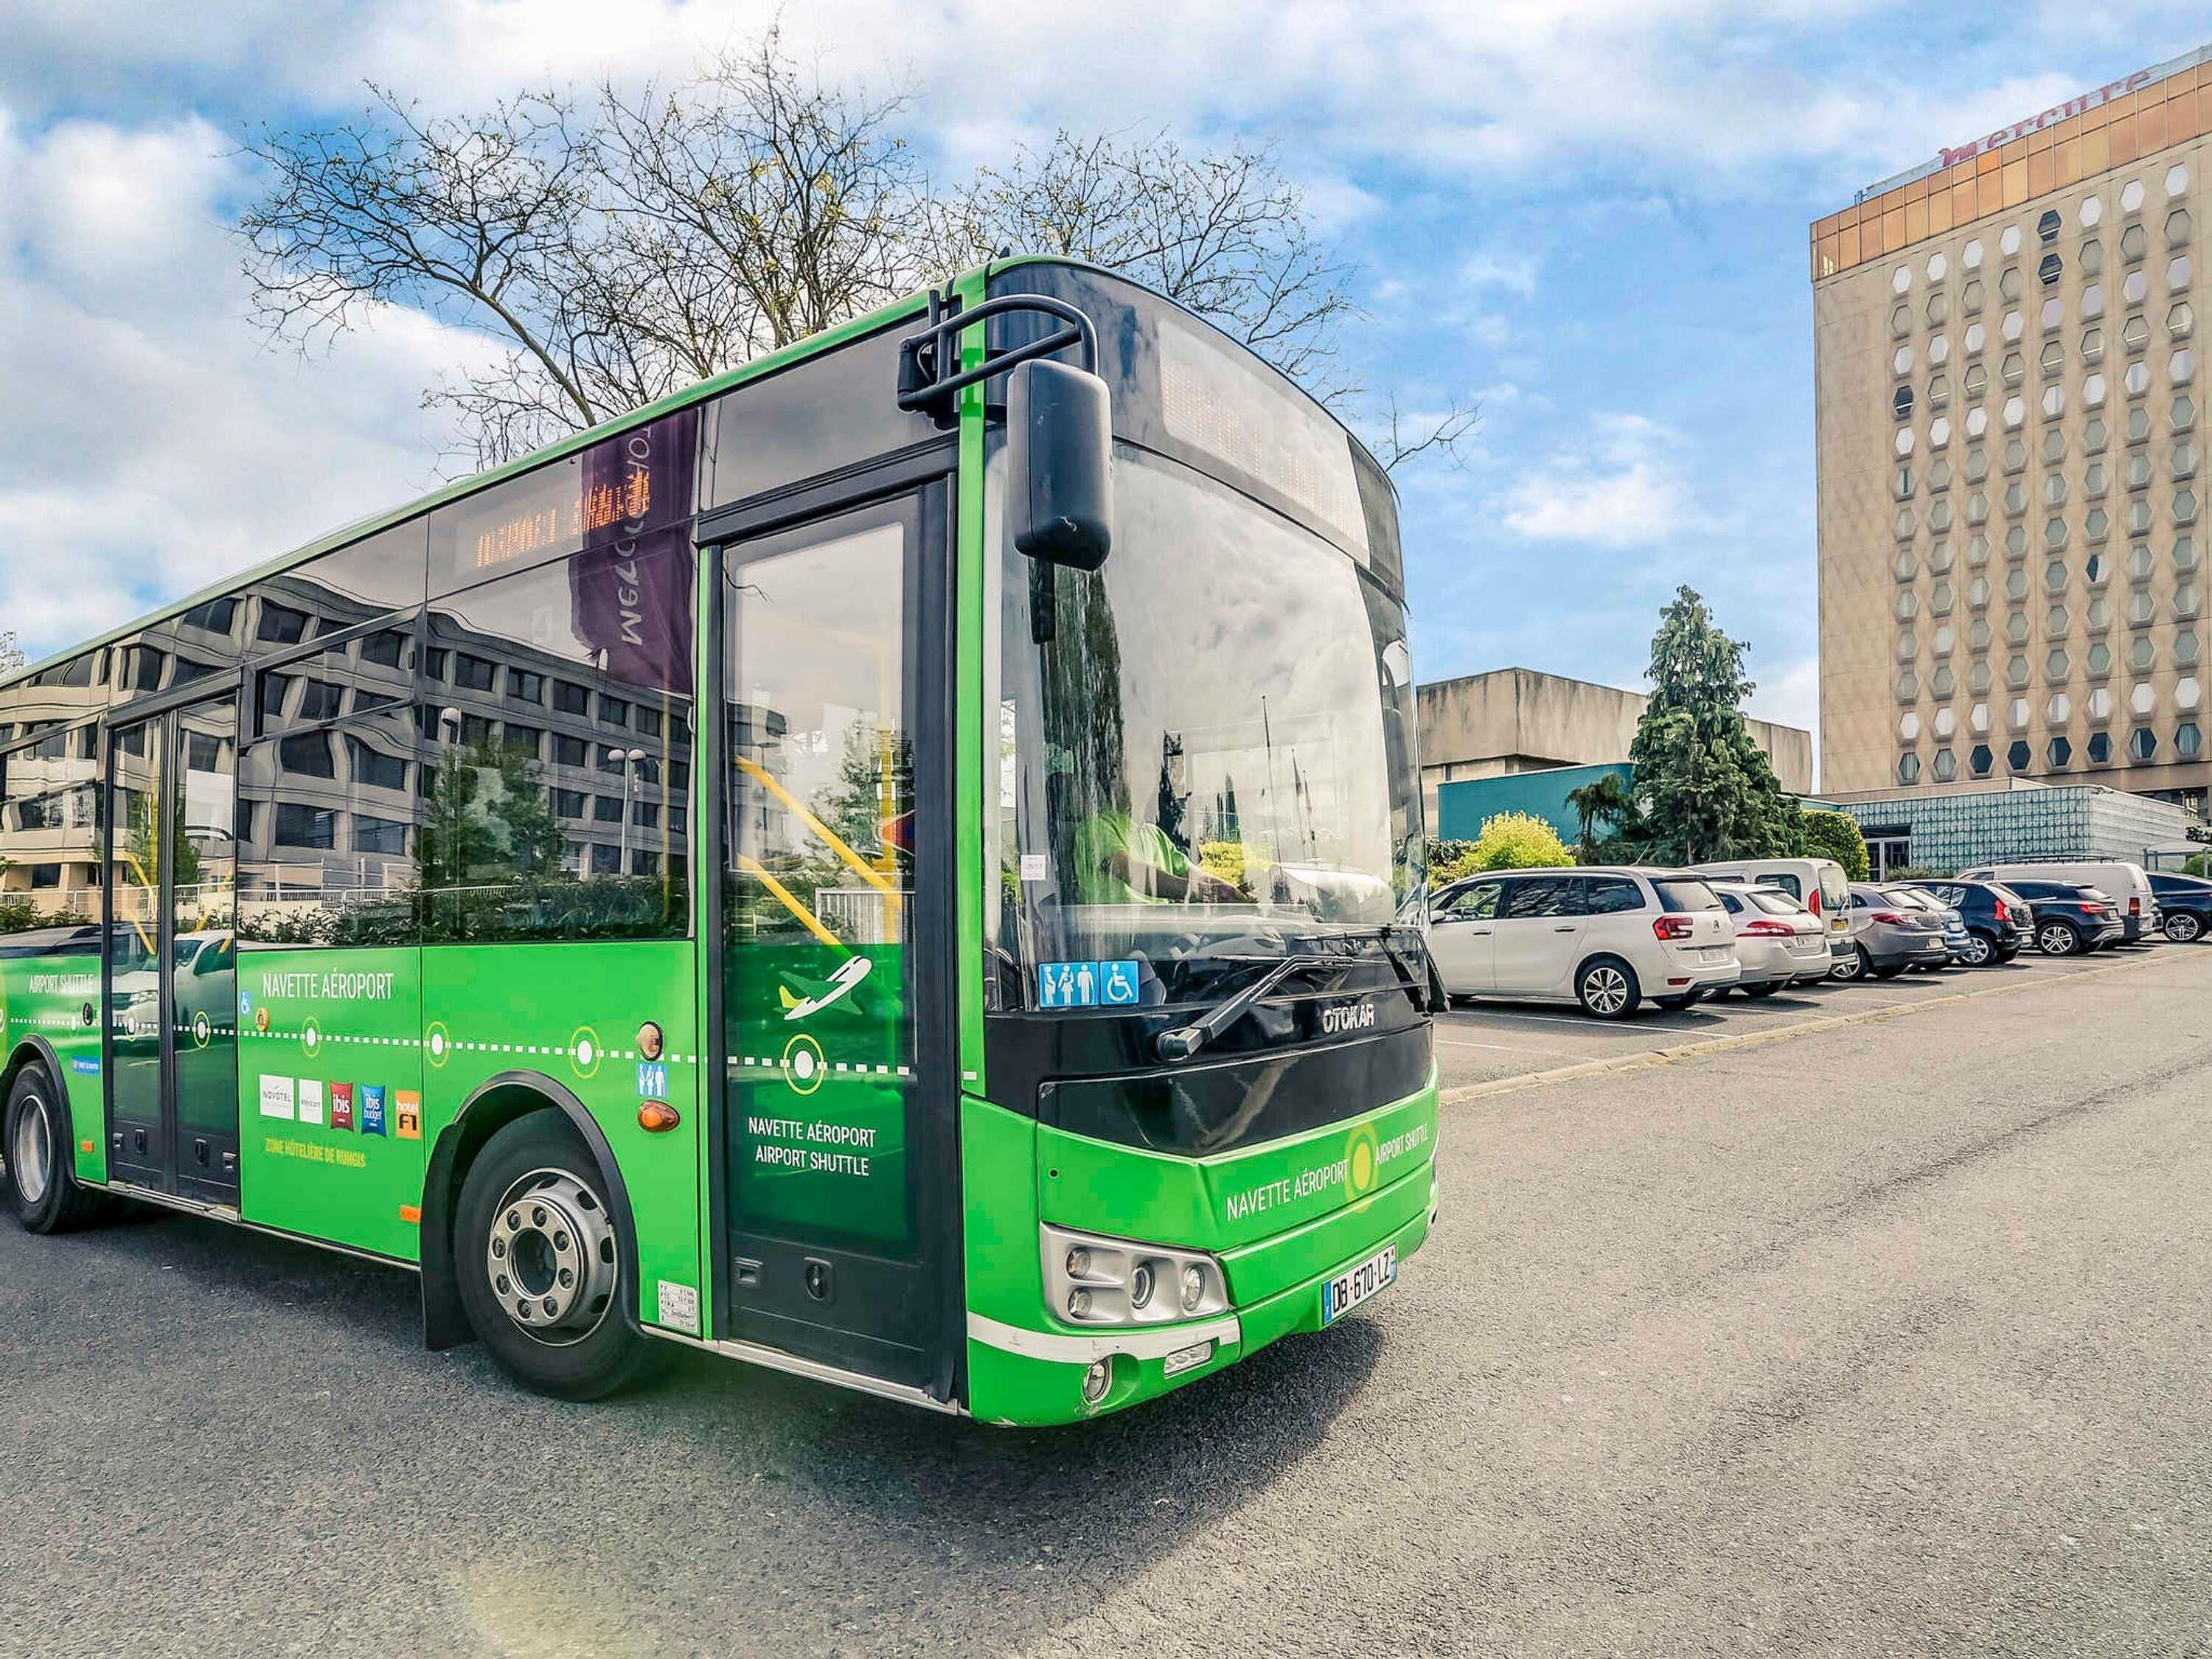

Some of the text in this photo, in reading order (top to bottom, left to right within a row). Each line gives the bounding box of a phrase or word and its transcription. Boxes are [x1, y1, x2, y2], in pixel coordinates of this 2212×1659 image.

[262, 967, 394, 999] NAVETTE AÉROPORT
[1323, 1004, 1375, 1033] OTOKAR
[333, 1093, 350, 1114] ibis
[366, 1094, 380, 1110] ibis
[399, 1113, 417, 1130] F1
[748, 1116, 877, 1148] NAVETTE AÉROPORT
[756, 1144, 869, 1176] AIRPORT SHUTTLE
[1374, 1123, 1428, 1165] AIRPORT SHUTTLE
[1227, 1158, 1349, 1221] NAVETTE AÉROPORT
